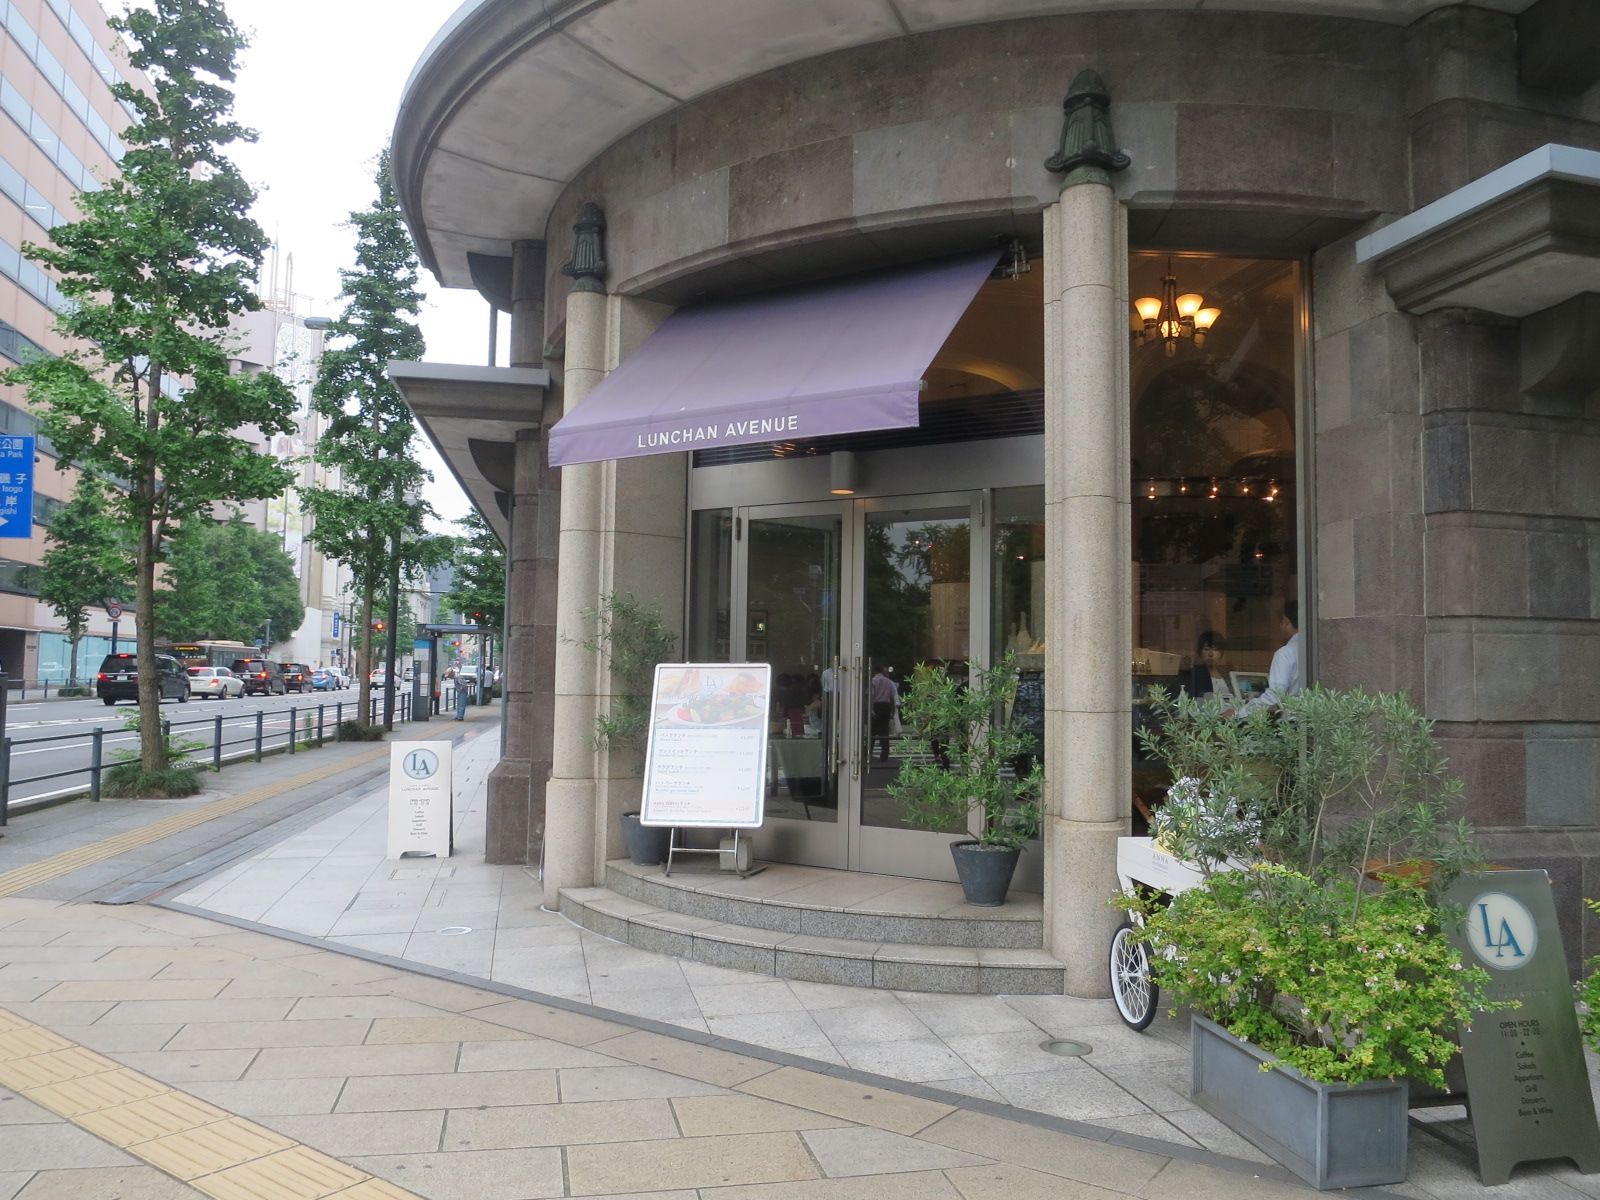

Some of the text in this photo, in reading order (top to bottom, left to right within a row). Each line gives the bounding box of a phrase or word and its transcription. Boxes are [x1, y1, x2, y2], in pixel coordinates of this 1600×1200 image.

[638, 415, 798, 448] LUNCHAN AVENUE
[0, 438, 23, 450] 公園
[7, 451, 23, 459] Park
[2, 485, 23, 493] Isogo
[1478, 903, 1525, 957] LA
[1499, 1020, 1540, 1029] OPEN HOURS
